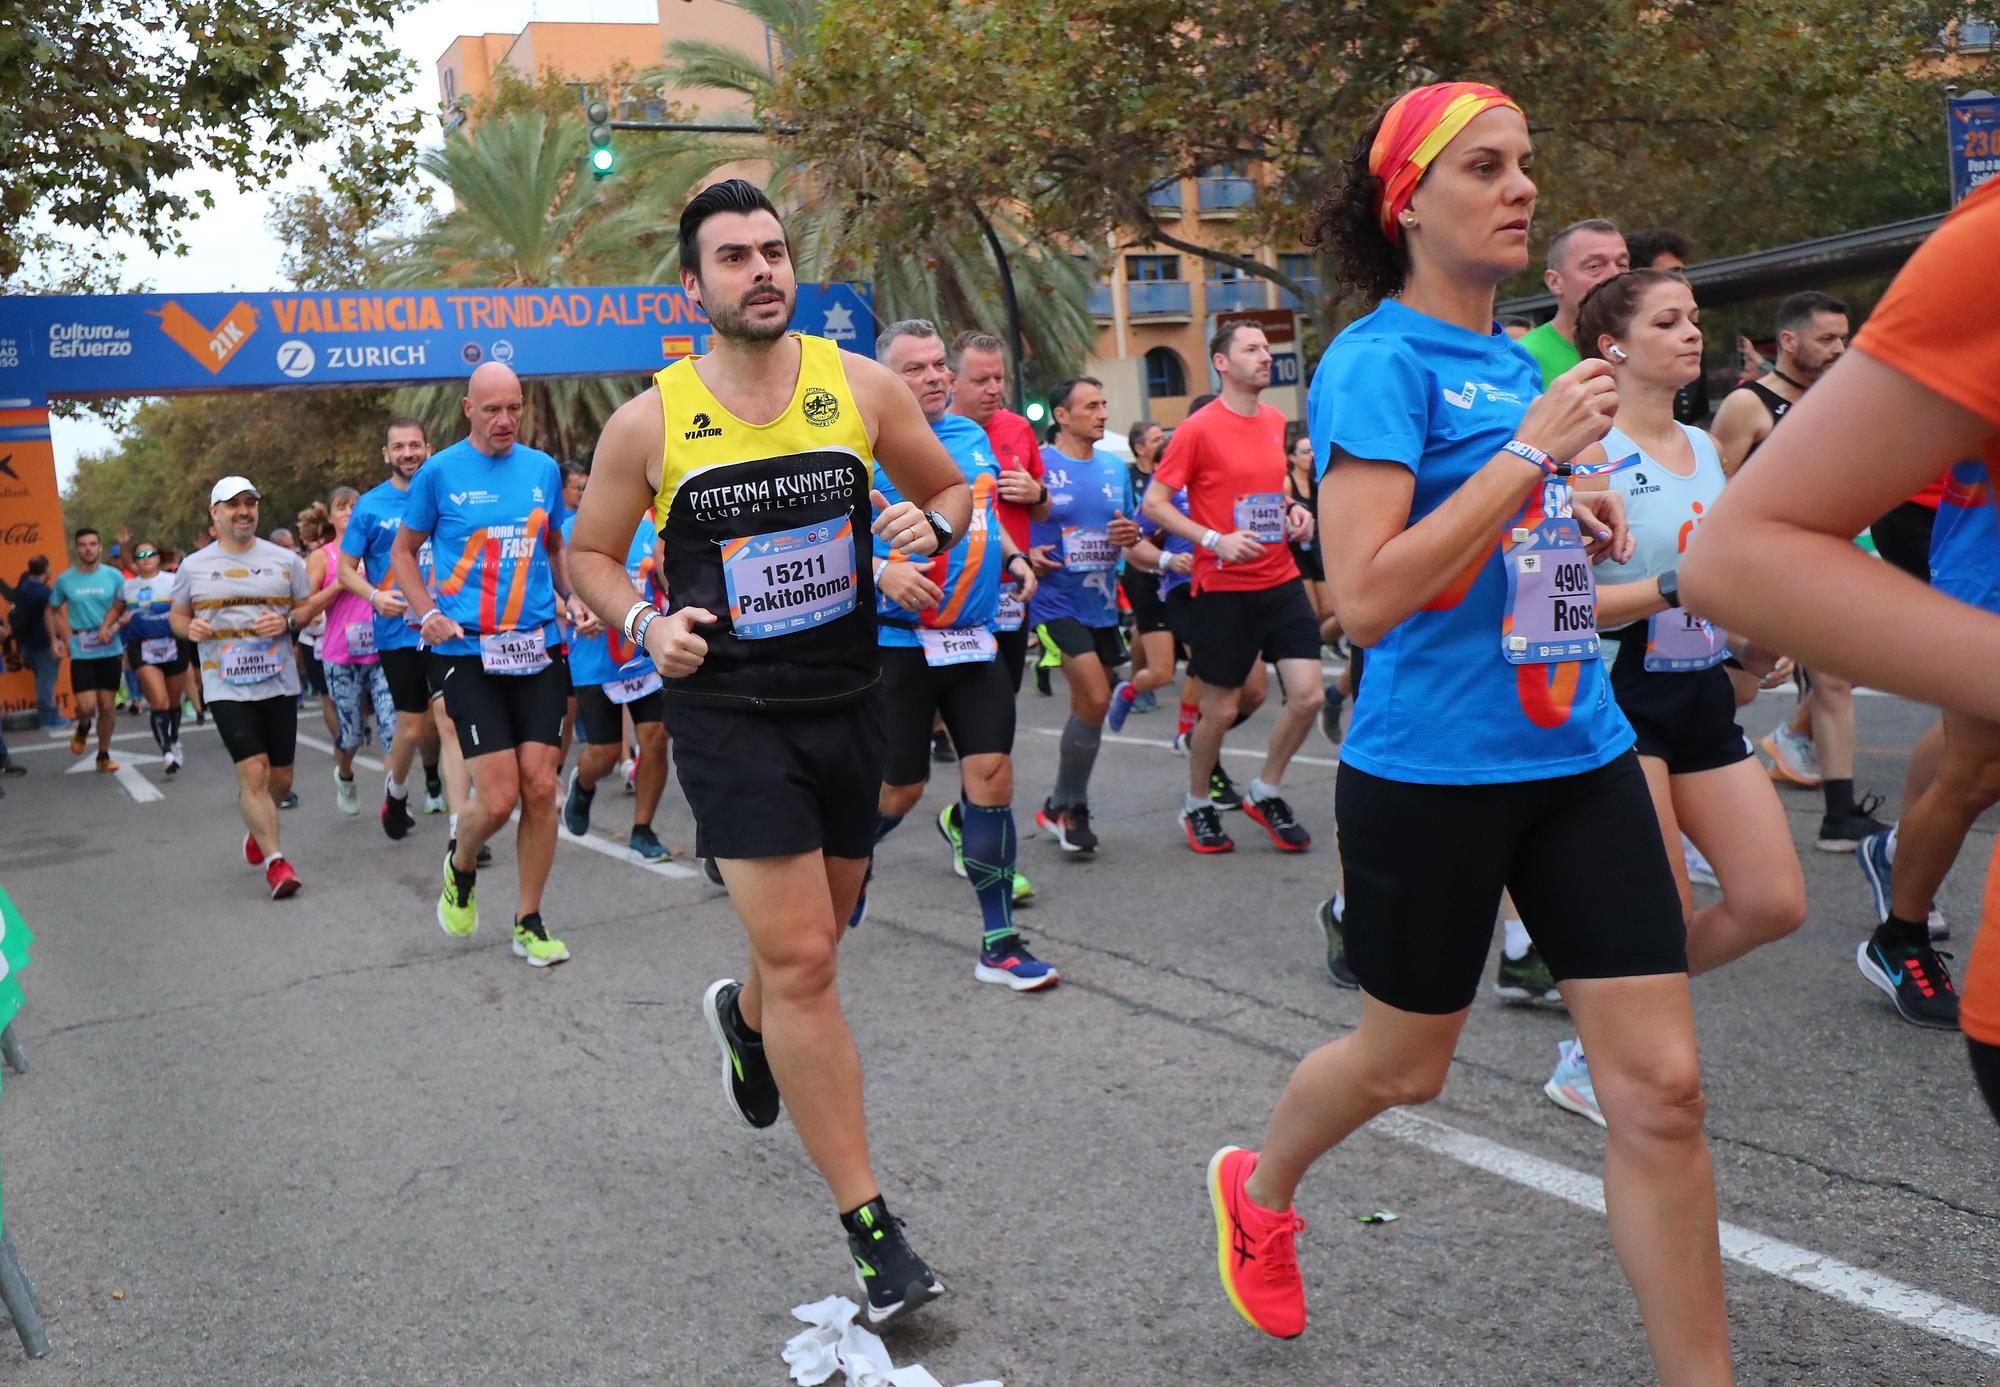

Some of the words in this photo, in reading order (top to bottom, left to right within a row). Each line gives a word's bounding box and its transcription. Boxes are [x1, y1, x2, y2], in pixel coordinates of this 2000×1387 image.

[272, 296, 442, 333] VALENCIA
[447, 293, 592, 329] TRINIDAD
[49, 322, 114, 341] Cultura
[114, 328, 130, 340] del
[209, 320, 244, 361] 21K
[49, 339, 133, 359] Esfuerzo
[327, 344, 426, 369] ZURICH
[1275, 358, 1296, 382] 10
[685, 428, 722, 440] VIATOR
[689, 480, 770, 510] PATERNA
[775, 467, 855, 497] RUNNERS
[1630, 485, 1661, 496] VIATOR
[696, 507, 741, 521] CLUB
[752, 488, 853, 513] ATLETISMO
[487, 525, 514, 539] BORN
[501, 537, 537, 559] FAST
[762, 554, 826, 587] 15211
[1555, 563, 1589, 592] 4909
[738, 575, 851, 614] PakitoRoma
[1554, 599, 1595, 632] Rosa
[501, 640, 535, 654] 14138
[943, 638, 982, 653] Frank
